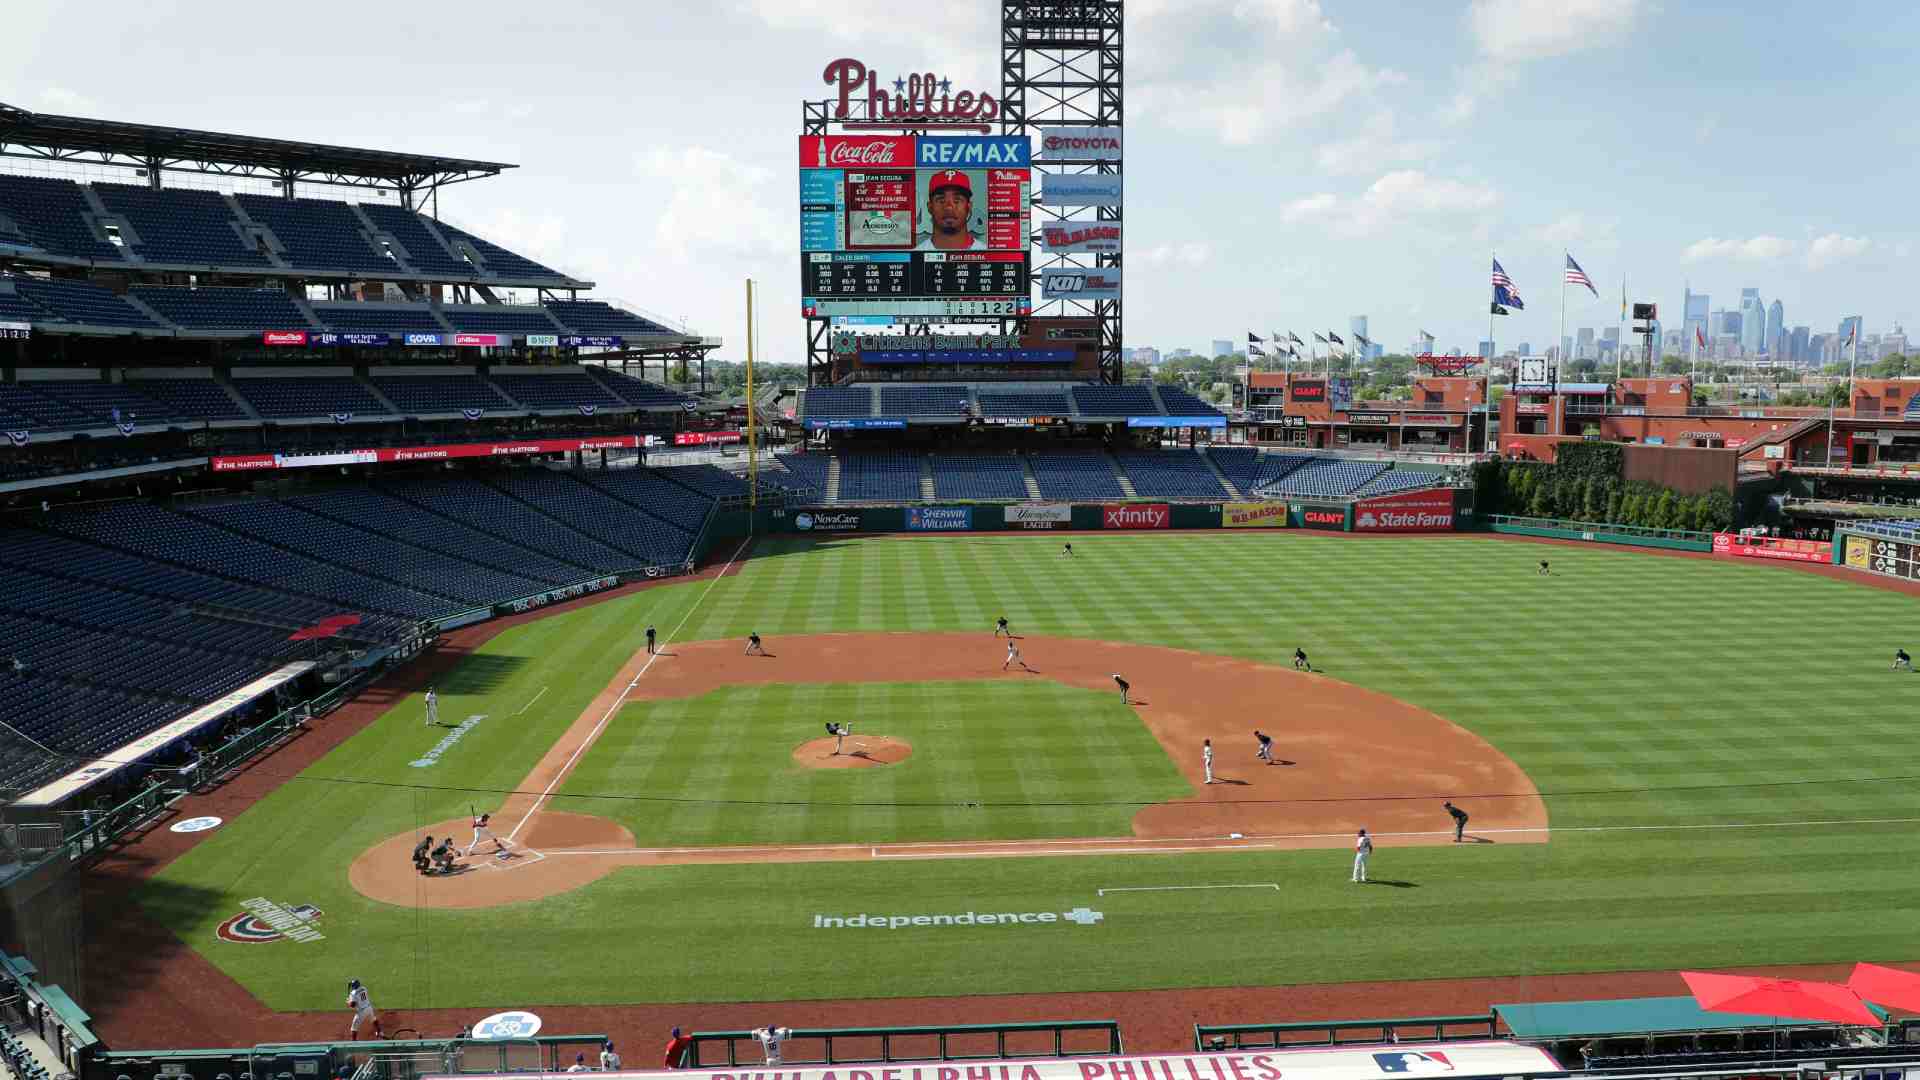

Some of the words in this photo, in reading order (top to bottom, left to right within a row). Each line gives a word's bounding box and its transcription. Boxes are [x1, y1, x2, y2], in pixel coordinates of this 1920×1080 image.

[823, 58, 999, 119] Phillies
[1063, 138, 1120, 149] TOYOTA
[922, 143, 1019, 162] RE/MAX
[981, 302, 989, 314] 1
[993, 302, 1002, 314] 2
[1005, 302, 1014, 314] 2
[409, 334, 436, 344] GOYA
[860, 333, 929, 350] Citizens
[934, 334, 976, 350] Bank
[981, 334, 1021, 350] Park
[414, 451, 447, 459] HARTFORD
[237, 460, 273, 469] HARTFORD
[814, 513, 860, 524] NovaCare
[922, 508, 967, 518] SHERWIN
[1107, 506, 1165, 527] xfinity
[1304, 511, 1345, 523] GIANT
[813, 910, 1057, 929] Independence
[711, 1064, 1042, 1080] ADELPHIA
[1078, 1055, 1282, 1080] PHILLIES
